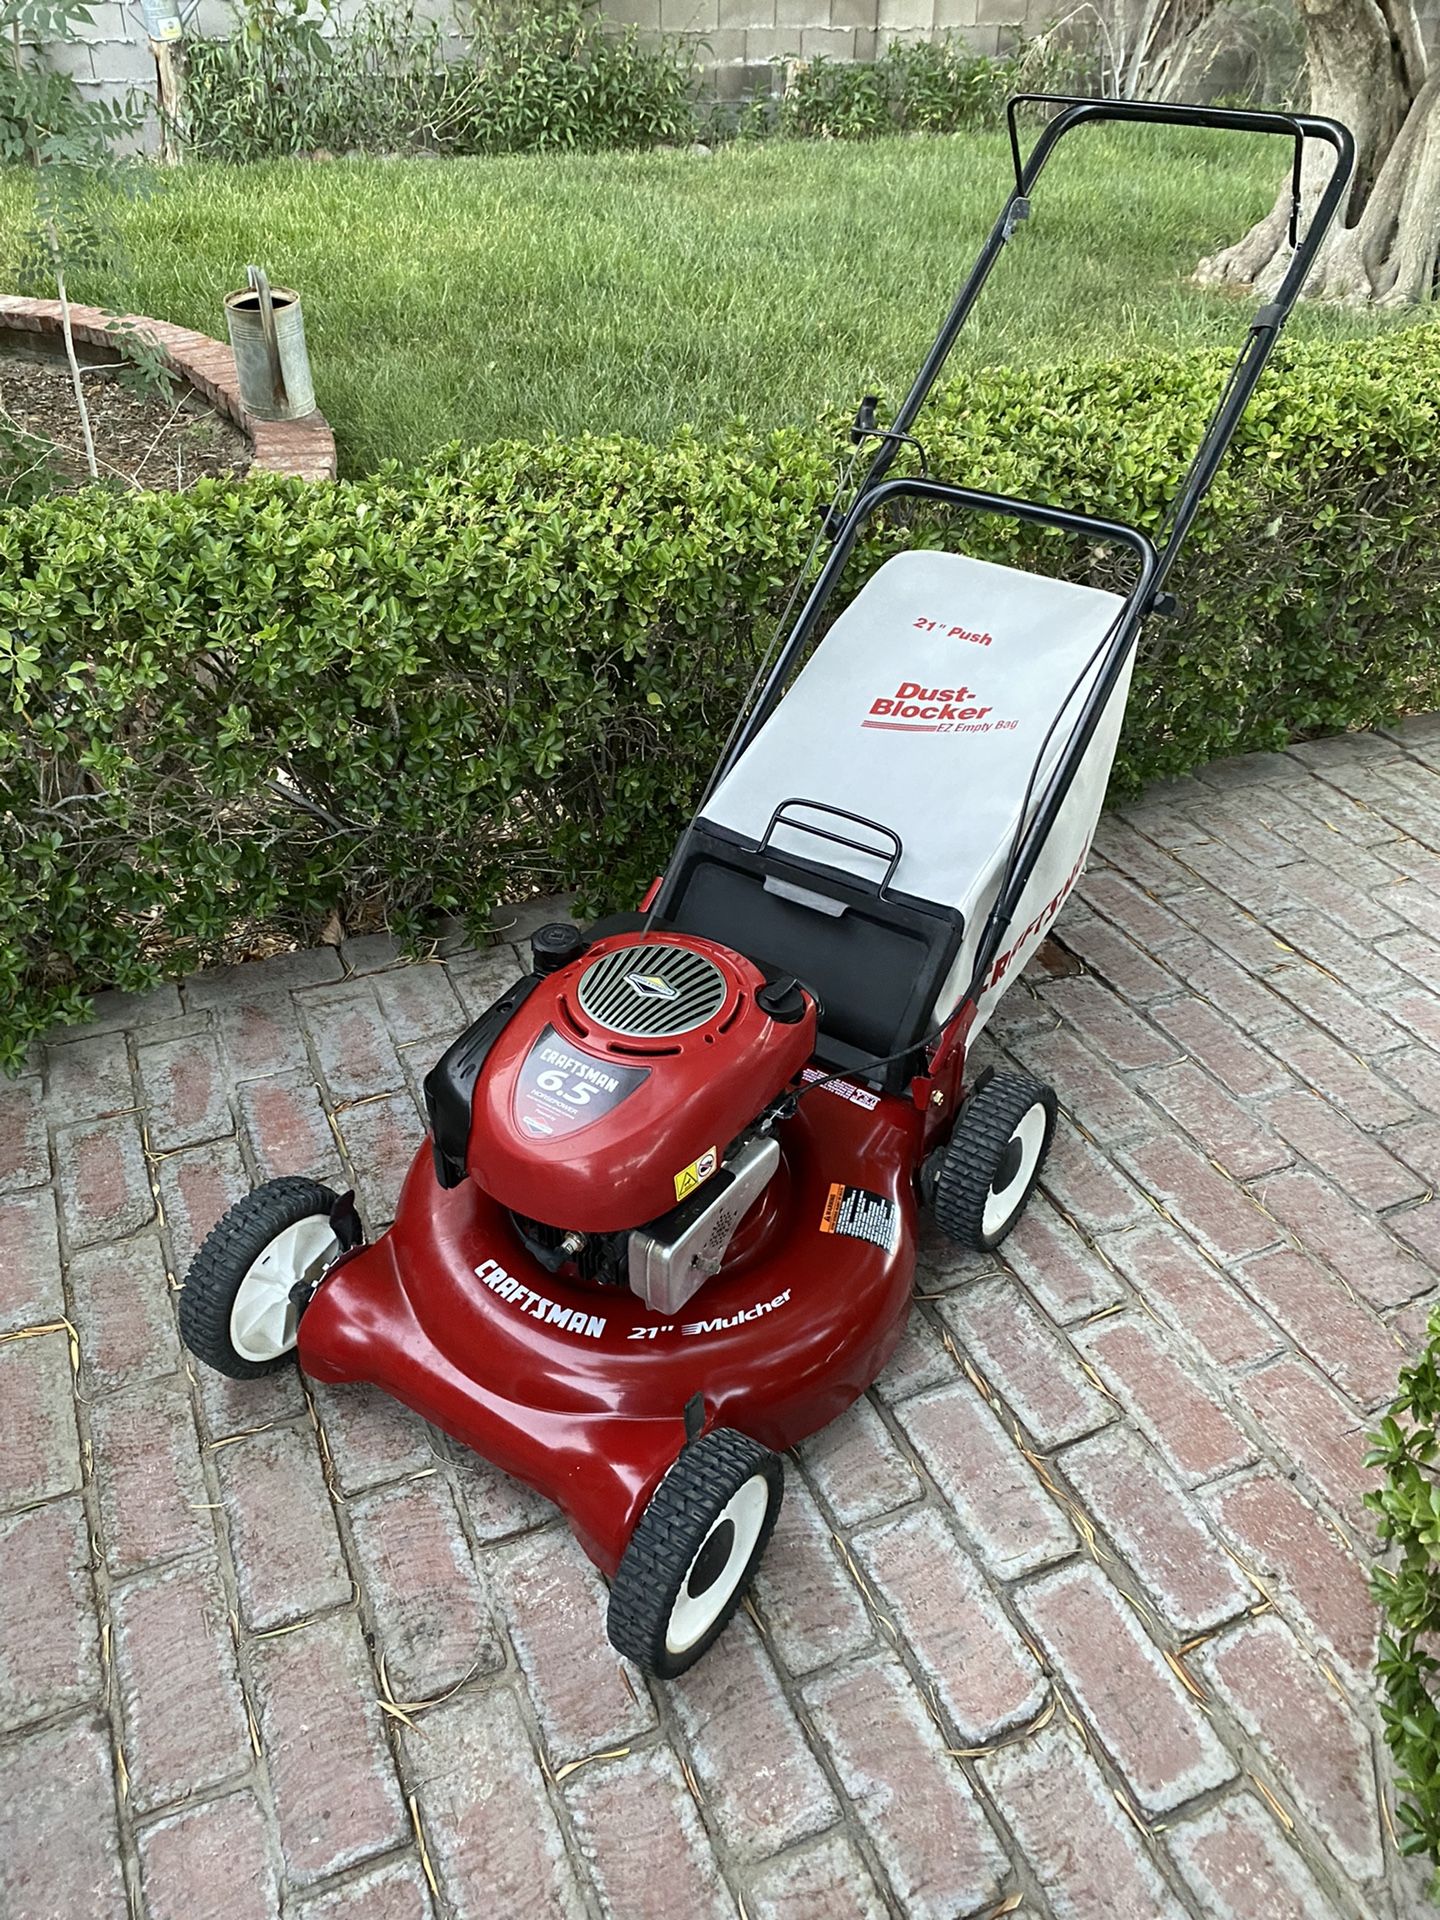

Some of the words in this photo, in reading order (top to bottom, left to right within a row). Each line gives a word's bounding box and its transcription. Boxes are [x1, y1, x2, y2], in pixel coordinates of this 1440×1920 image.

[913, 617, 946, 632] 21"
[947, 626, 993, 646] Push
[895, 682, 976, 702] Dust-
[869, 698, 993, 720] Blocker
[936, 723, 953, 733] EZ
[954, 723, 993, 734] Empty
[995, 719, 1019, 731] Bag
[979, 829, 1092, 994] RAFTS
[540, 1048, 619, 1093] CRAFTSMAN
[537, 1070, 599, 1105] 6.5
[474, 1259, 607, 1338] CRAFTSMAN
[627, 1325, 674, 1339] 21"
[697, 1288, 792, 1333] Mulcher
